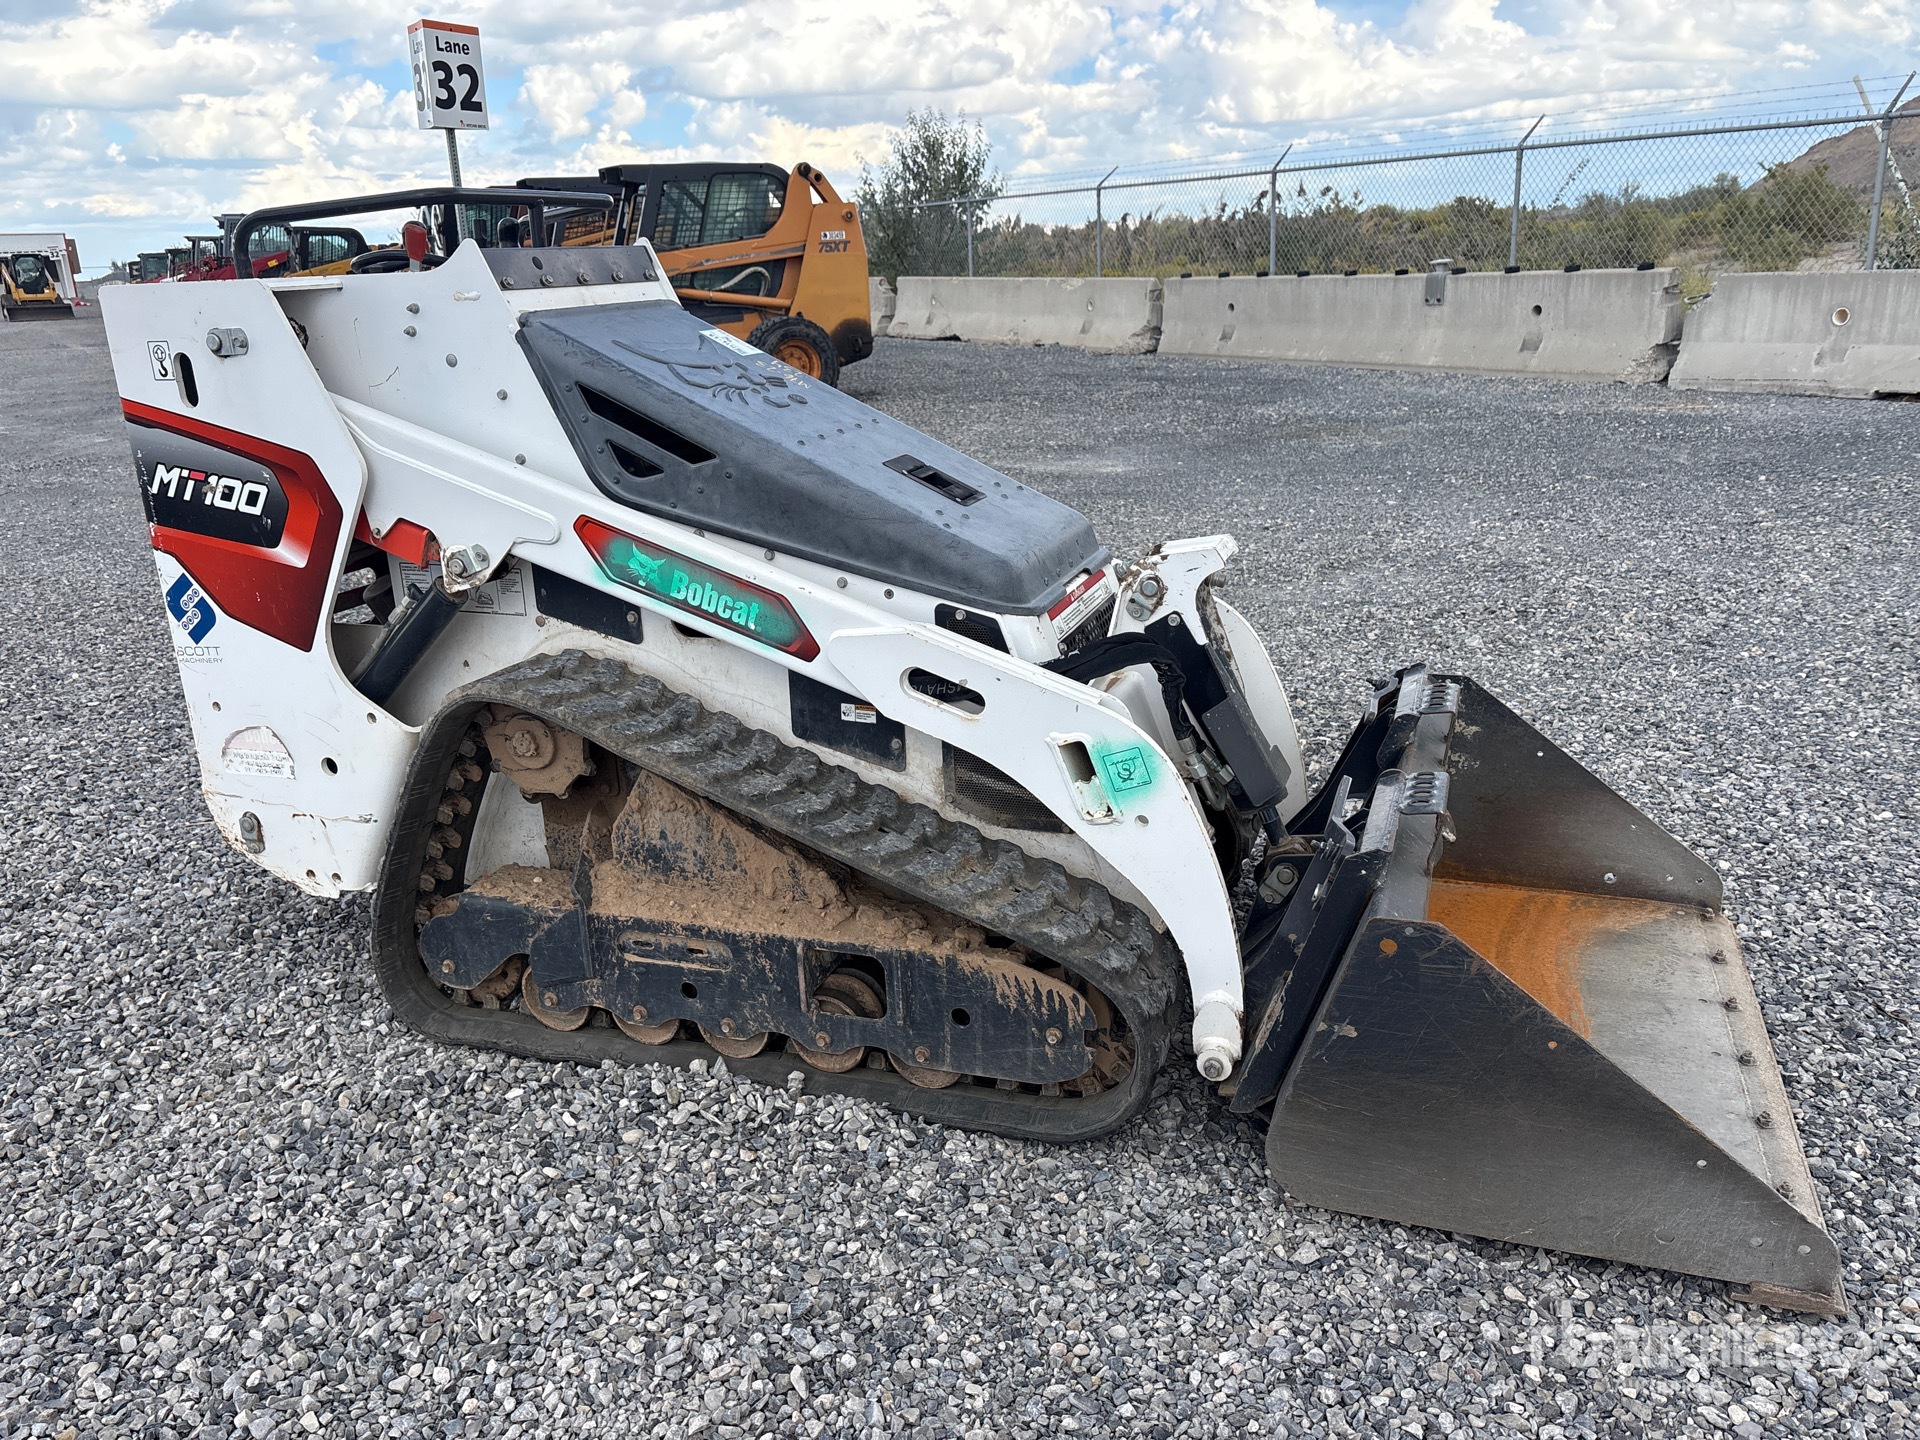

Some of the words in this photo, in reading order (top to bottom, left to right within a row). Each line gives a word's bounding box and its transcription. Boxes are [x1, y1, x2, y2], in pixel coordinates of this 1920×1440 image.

[435, 36, 470, 55] Lane
[432, 60, 483, 112] 32
[818, 241, 851, 253] 75XT
[152, 463, 269, 516] MT100
[670, 569, 759, 631] Bobcat
[177, 646, 220, 657] SCOTT
